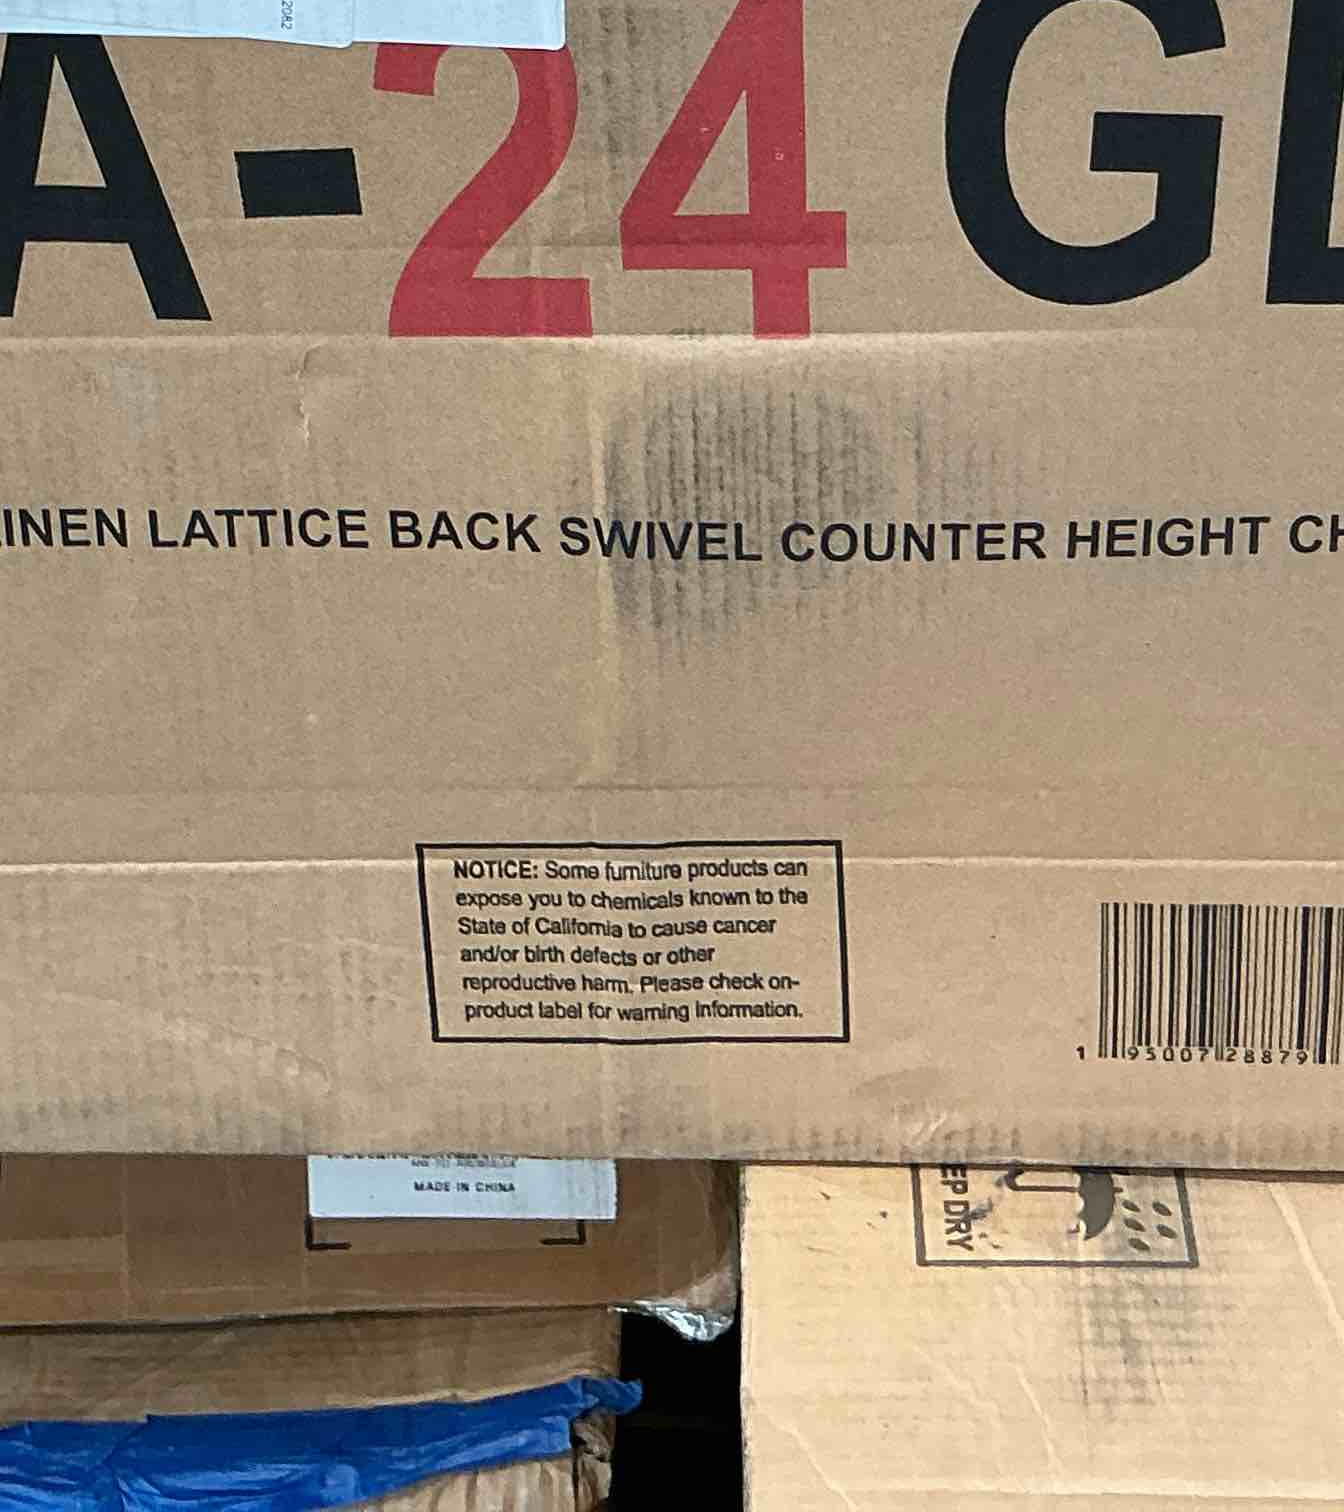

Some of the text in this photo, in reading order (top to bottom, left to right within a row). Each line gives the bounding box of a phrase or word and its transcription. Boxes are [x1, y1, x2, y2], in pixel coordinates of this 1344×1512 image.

[148, 508, 369, 555] LATTICE
[389, 510, 541, 552] BACK
[560, 511, 762, 567] SWIVEL
[781, 521, 1046, 562] COUNTER
[1067, 516, 1271, 559] HEIGHT
[453, 858, 808, 882] NOTICE: Some furniture products can
[456, 887, 808, 911] expose you to chemicals known to the
[458, 917, 777, 938] State of California to cause cancer
[460, 945, 715, 967] and/or birth defects or other
[462, 973, 576, 994] reproductive
[640, 976, 704, 994] Please
[709, 972, 764, 990] check
[465, 1000, 803, 1023] product label for warning information.
[414, 1181, 515, 1192] MADE IN CHINA
[943, 1199, 975, 1252] DRY
